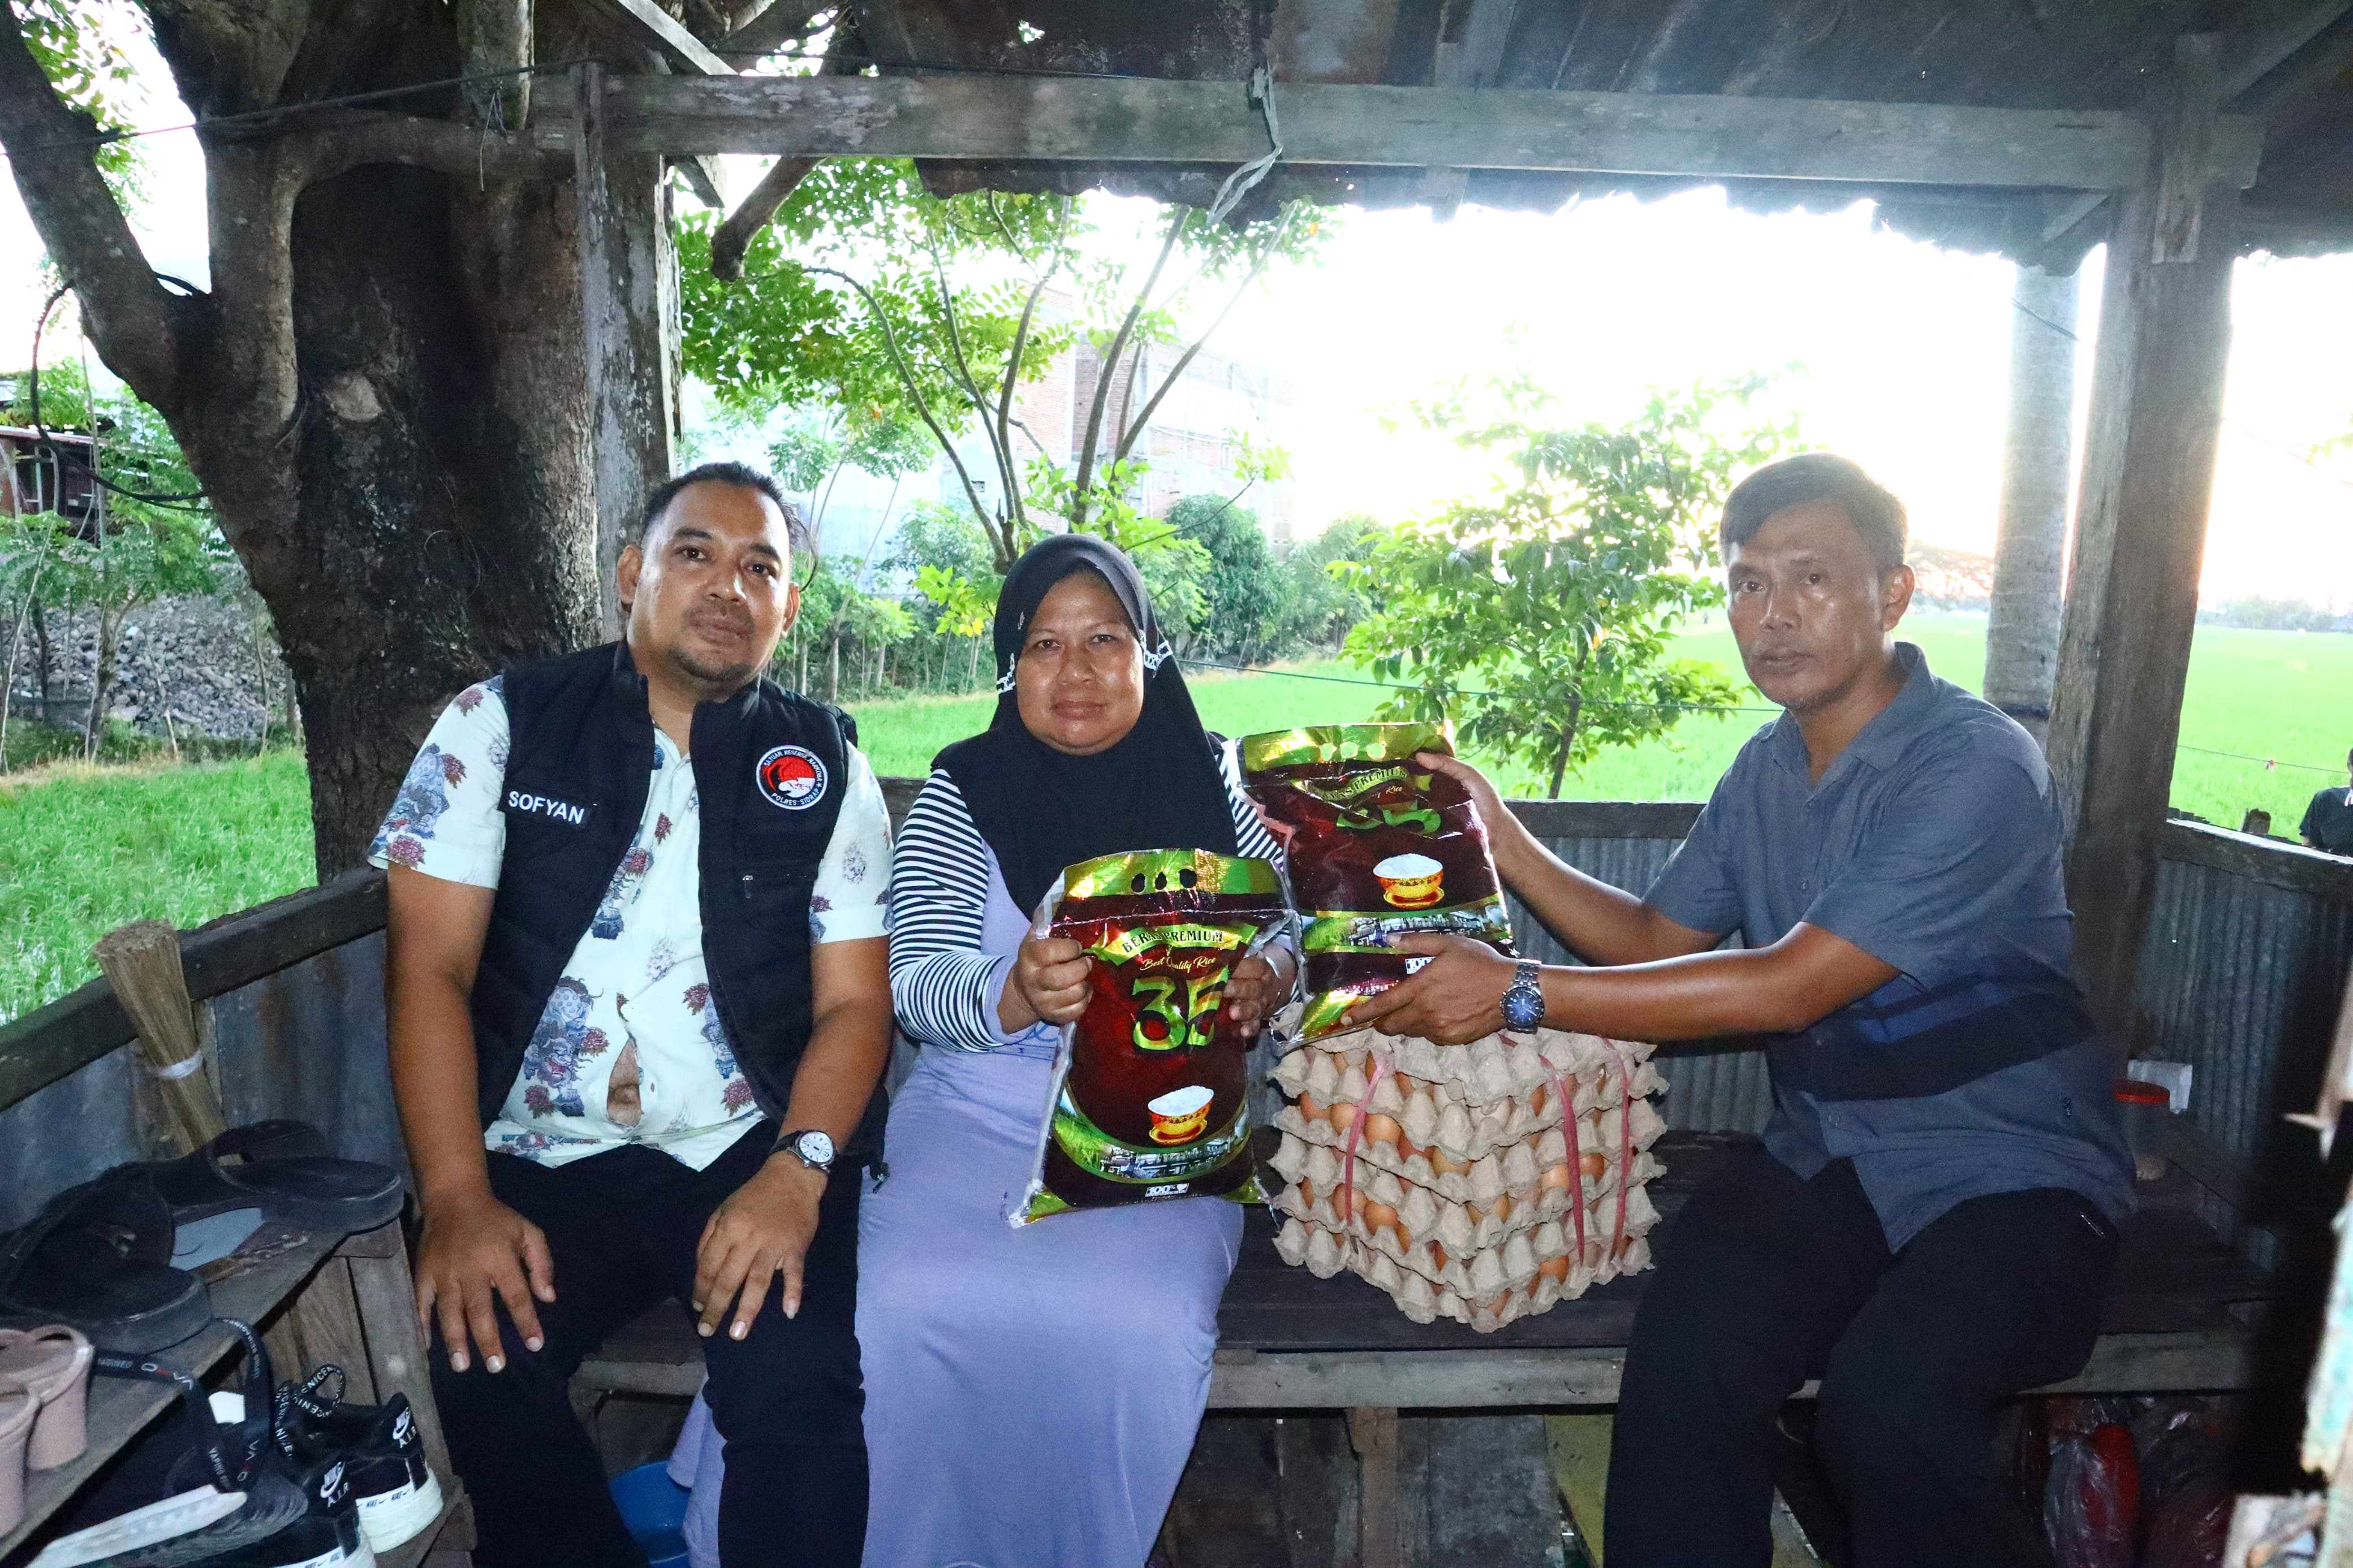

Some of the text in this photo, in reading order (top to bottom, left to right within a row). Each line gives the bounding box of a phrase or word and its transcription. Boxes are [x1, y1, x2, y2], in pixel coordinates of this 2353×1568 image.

[1352, 768, 1407, 790] PREMIUM
[771, 788, 820, 806] POLRES SIDRAP
[1385, 785, 1403, 794] Rice
[508, 791, 585, 824] SOFYAN
[1163, 930, 1224, 943] PREMIUM
[1140, 956, 1216, 974] Best Quality Rice
[399, 1426, 417, 1449] AIR
[327, 1481, 349, 1508] AIR
